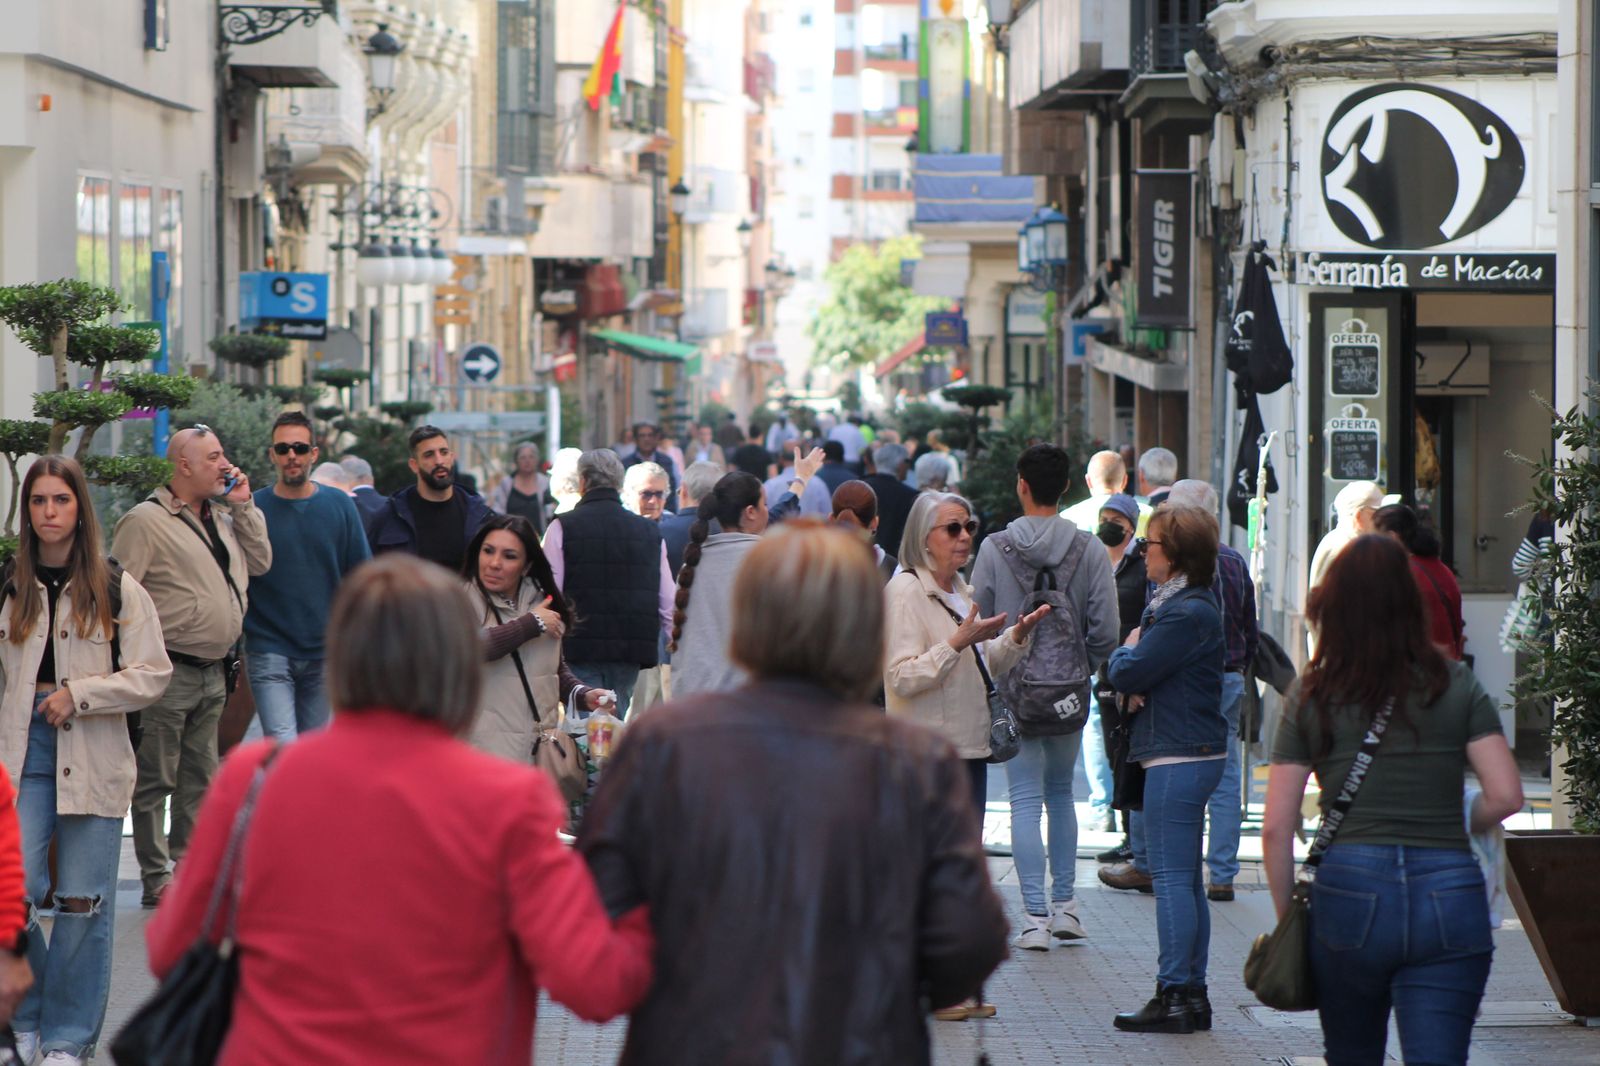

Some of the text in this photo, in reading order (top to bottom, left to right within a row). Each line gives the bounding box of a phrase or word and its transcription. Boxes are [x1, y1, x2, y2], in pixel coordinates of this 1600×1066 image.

[1153, 199, 1174, 298] TIGER
[1421, 256, 1448, 278] de
[1454, 255, 1544, 282] Macías
[1332, 334, 1378, 344] OFERTA
[1331, 420, 1377, 429] OFERTA
[1053, 692, 1081, 720] DC
[1337, 751, 1373, 803] BIMBA
